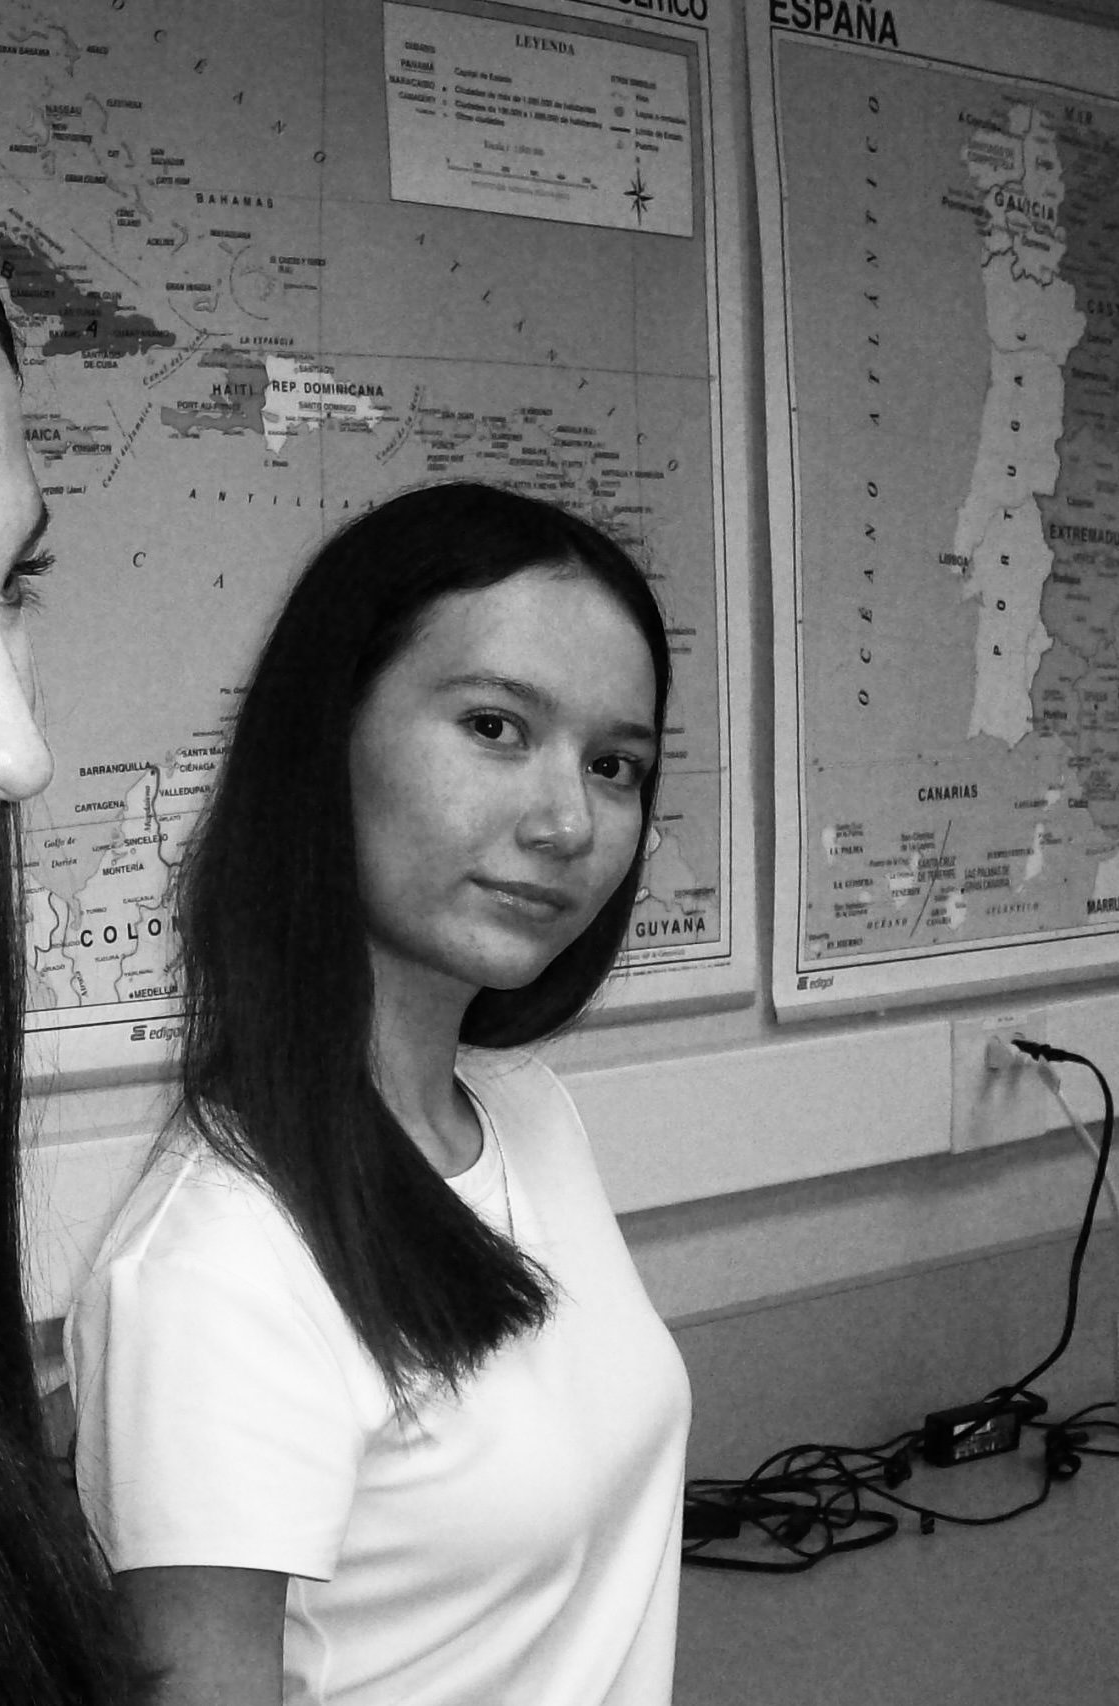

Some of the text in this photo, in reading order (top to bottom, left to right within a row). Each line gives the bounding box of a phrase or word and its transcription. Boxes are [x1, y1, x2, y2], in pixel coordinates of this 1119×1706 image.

[515, 34, 576, 56] LEYENDA
[195, 193, 274, 209] BAHAMAS
[994, 191, 1055, 221] GALICIA
[212, 383, 254, 396] HAITI
[304, 382, 384, 397] DOMINICANA
[992, 333, 1027, 656] PORTUGAL
[857, 481, 880, 706] OCÉANO
[79, 761, 151, 777] BARRANQUILLA
[179, 761, 217, 773] CIÉNAGA
[917, 784, 979, 802] CANARIAS
[74, 799, 125, 813] CARTAGENA
[102, 861, 145, 876] MONTERÍA
[635, 916, 706, 938] GUYANA
